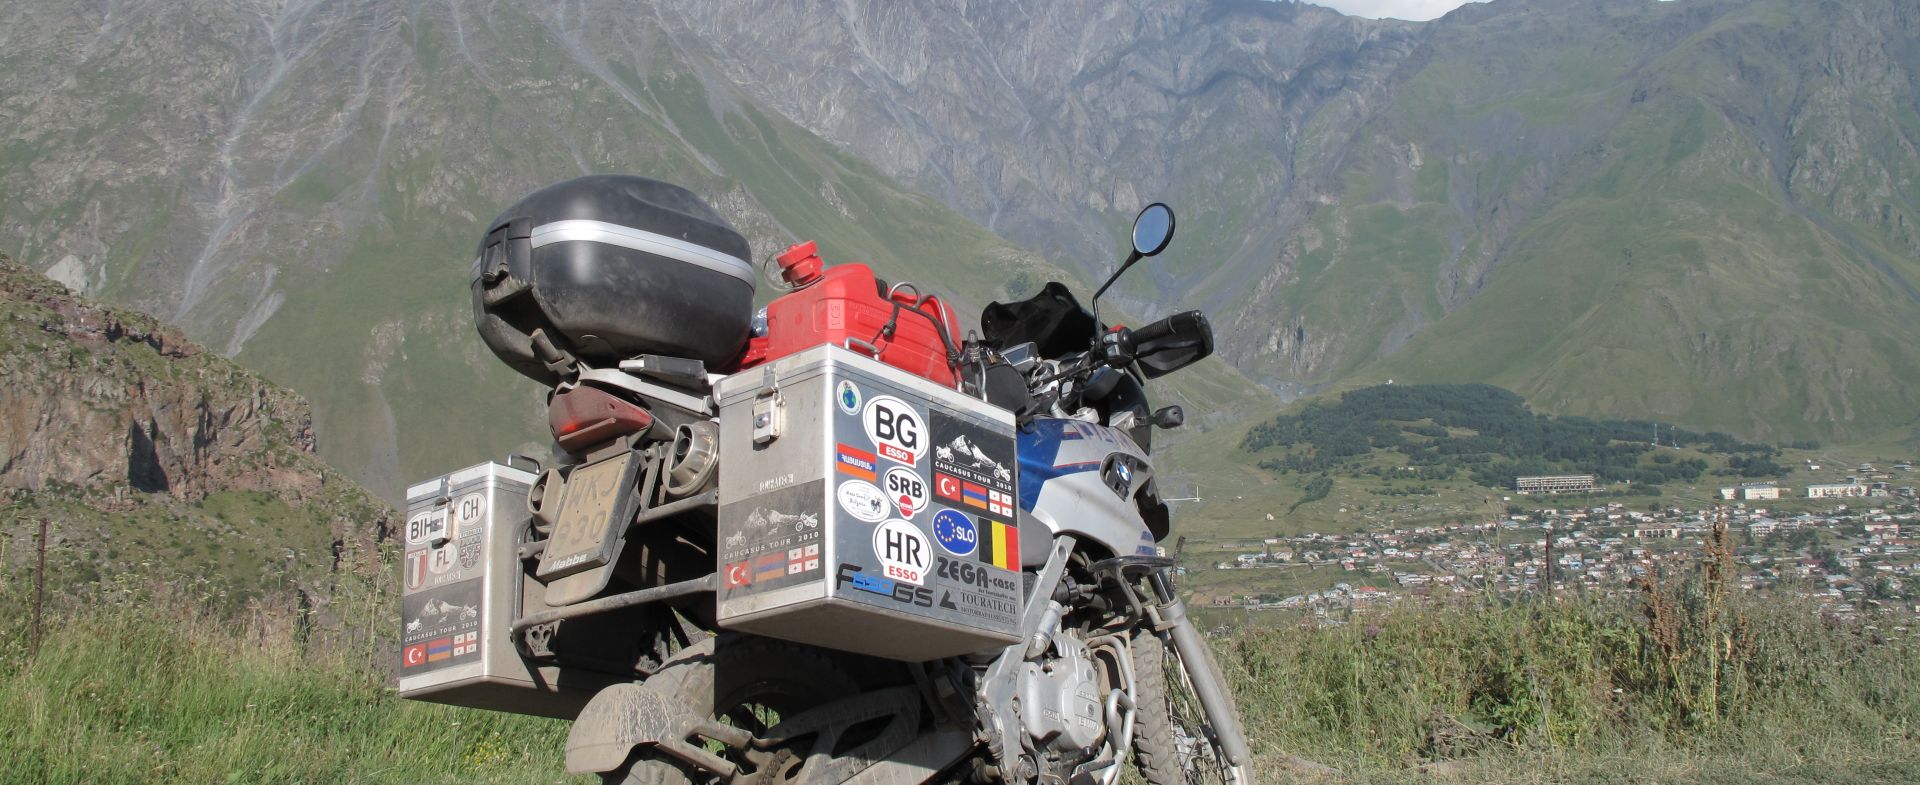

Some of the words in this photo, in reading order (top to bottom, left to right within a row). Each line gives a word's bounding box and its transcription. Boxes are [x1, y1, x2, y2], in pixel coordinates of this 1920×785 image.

[875, 403, 917, 450] BG
[885, 446, 909, 461] ESSO
[888, 473, 922, 499] SRB
[935, 461, 971, 478] CAUCASUS
[973, 473, 991, 485] TOUR
[996, 481, 1012, 491] 2010
[463, 497, 479, 521] CH
[410, 516, 432, 541] BIH
[956, 525, 975, 543] SLO
[724, 546, 766, 560] CAUCASUS
[769, 538, 791, 549] TOUR
[798, 531, 819, 542] 2010
[885, 528, 923, 568] HR
[436, 549, 450, 567] FL
[888, 565, 918, 582] ESSO
[937, 556, 1016, 591] ZEGA-case
[960, 591, 1016, 615] TOURATECH
[404, 630, 437, 642] CAUCASUS
[440, 625, 457, 634] TOUR
[462, 620, 478, 629] 2010
